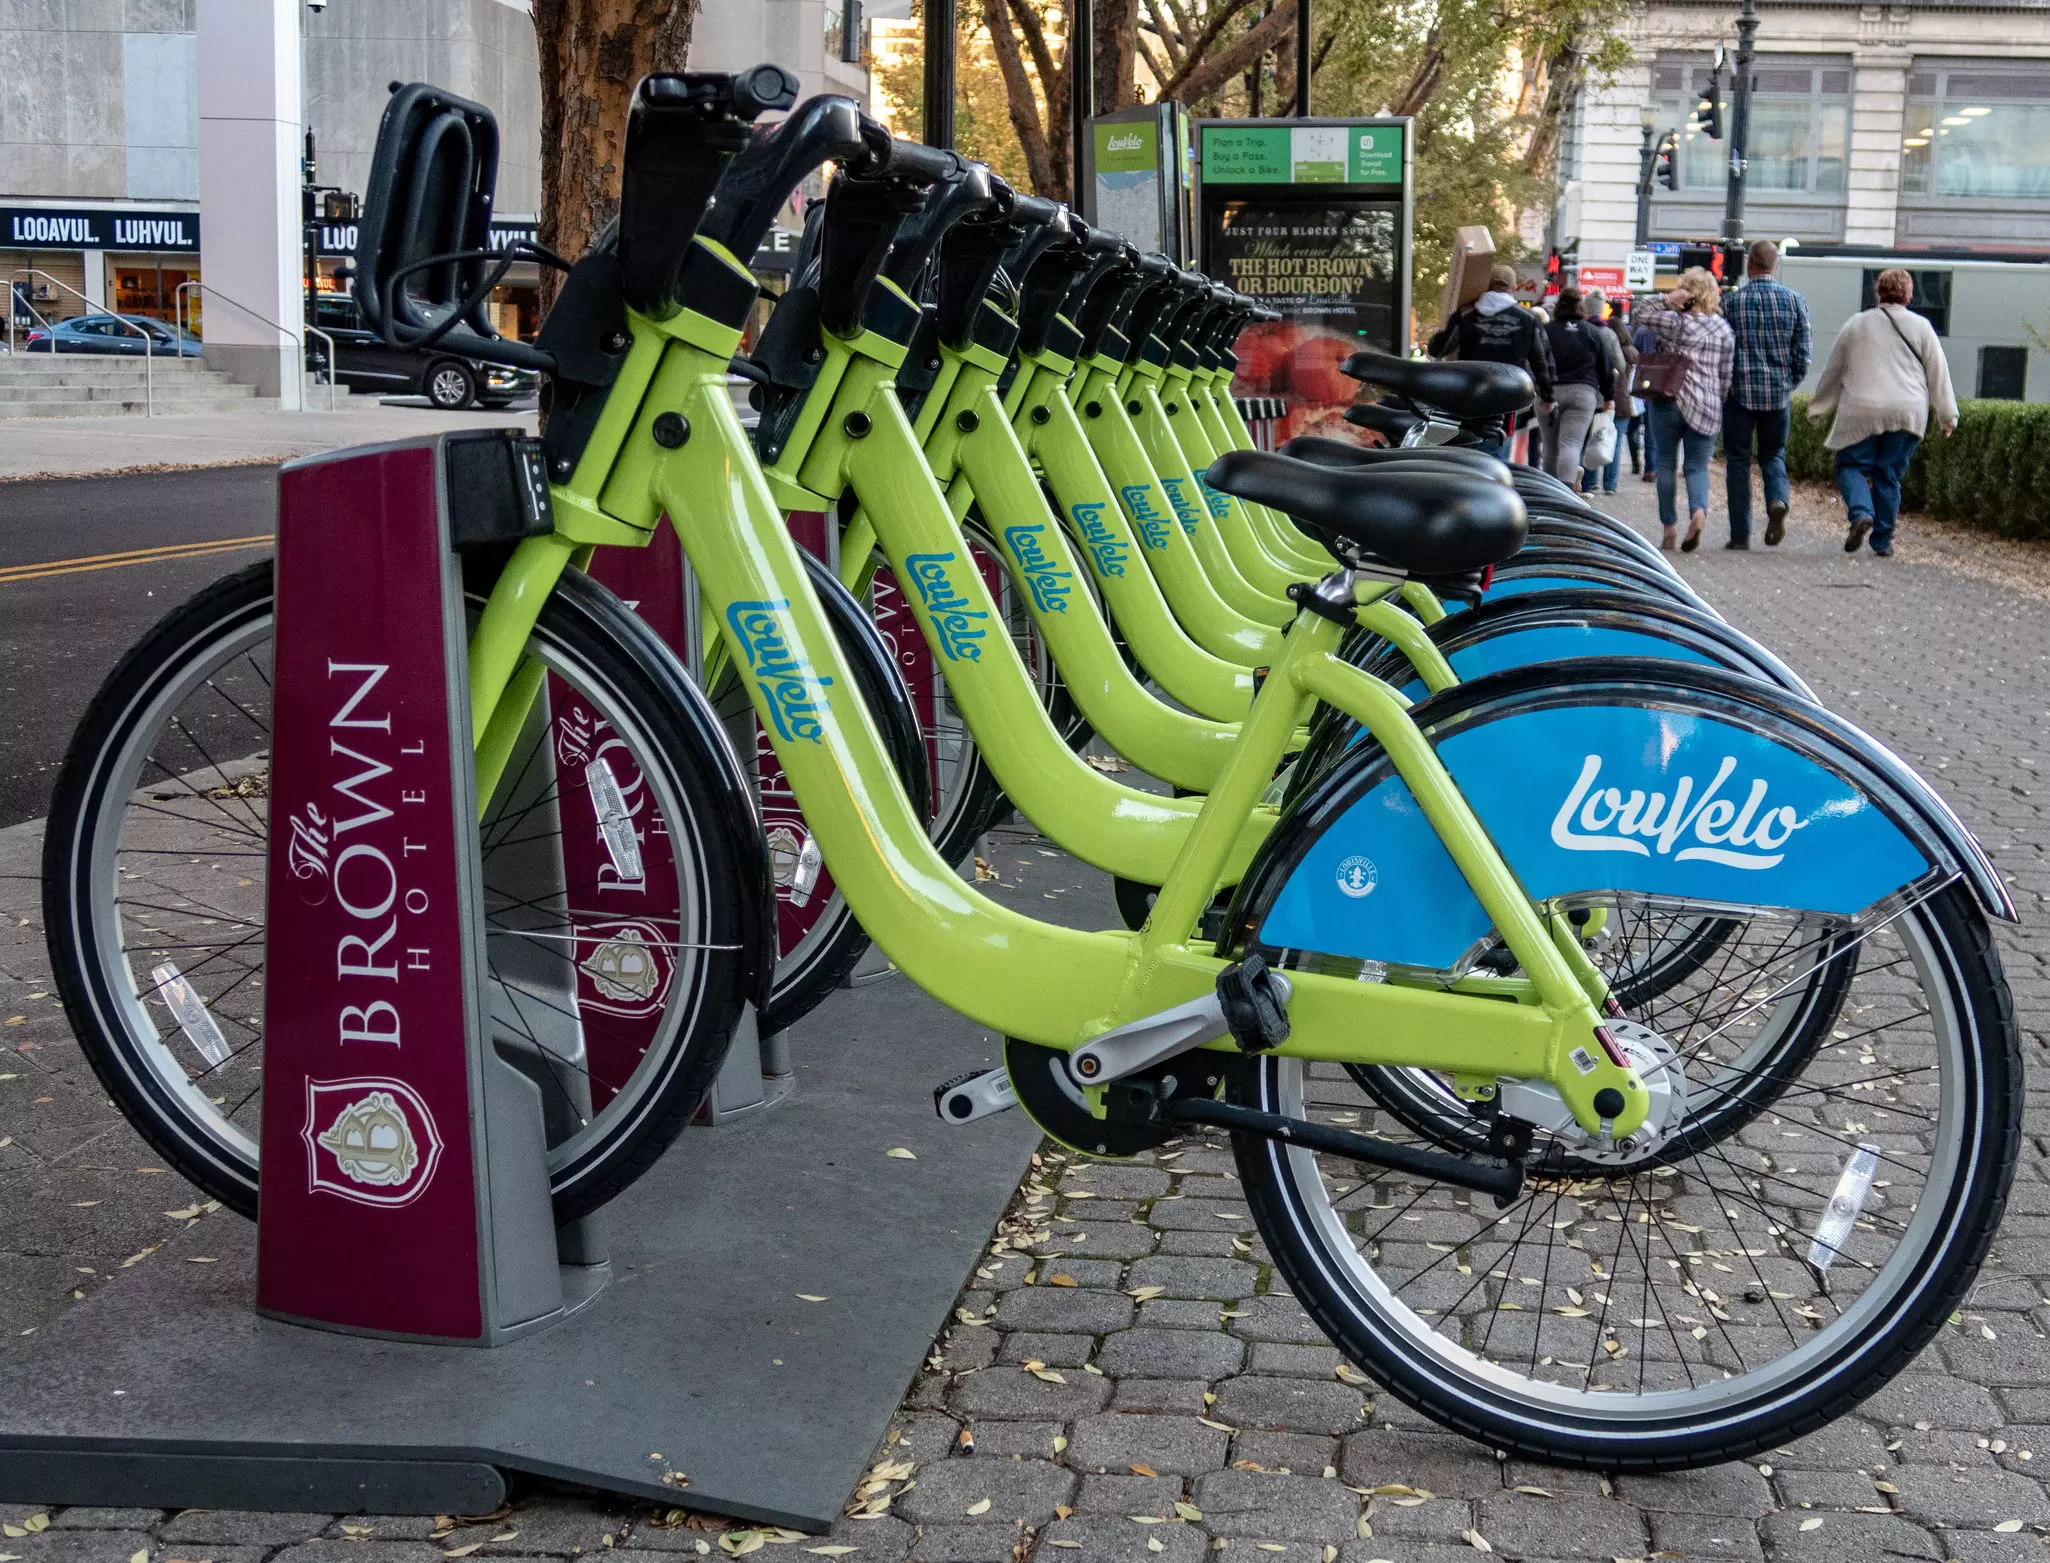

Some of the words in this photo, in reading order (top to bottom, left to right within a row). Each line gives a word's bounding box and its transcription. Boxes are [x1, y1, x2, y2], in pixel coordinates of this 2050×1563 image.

[1107, 132, 1144, 151] LouVelo
[1213, 138, 1234, 147] Plan
[1213, 152, 1230, 161] Buy
[1213, 166, 1246, 174] Unlock
[13, 216, 100, 243] LOOAVUL.
[115, 219, 193, 245] LUHVUL.
[1225, 227, 1252, 236] JUST
[1258, 227, 1288, 236] FOUR
[1292, 227, 1338, 236] BLOCKS
[1245, 240, 1291, 257] Which
[1293, 249, 1327, 257] came
[1631, 256, 1648, 264] ONE
[1229, 258, 1265, 275] THE
[1267, 258, 1304, 275] HOT
[1306, 258, 1373, 276] BROWN
[1630, 266, 1648, 274] WAY
[1237, 277, 1264, 294] OR
[1266, 277, 1364, 294] BOURBON?
[1303, 306, 1331, 314] BROWN
[1332, 306, 1357, 314] HOTEL
[1121, 484, 1171, 550] LouVelo
[1161, 478, 1200, 536] LouVelo
[1070, 501, 1129, 579] LouVelo
[1003, 523, 1072, 615] LouVelo
[905, 551, 989, 664] LouVelo
[726, 598, 834, 745] LouVelo
[558, 706, 592, 782] The
[1550, 754, 1809, 870] LouVelo
[287, 801, 330, 900] The
[327, 657, 401, 1050] BROWN
[401, 738, 431, 974] HOTEL
